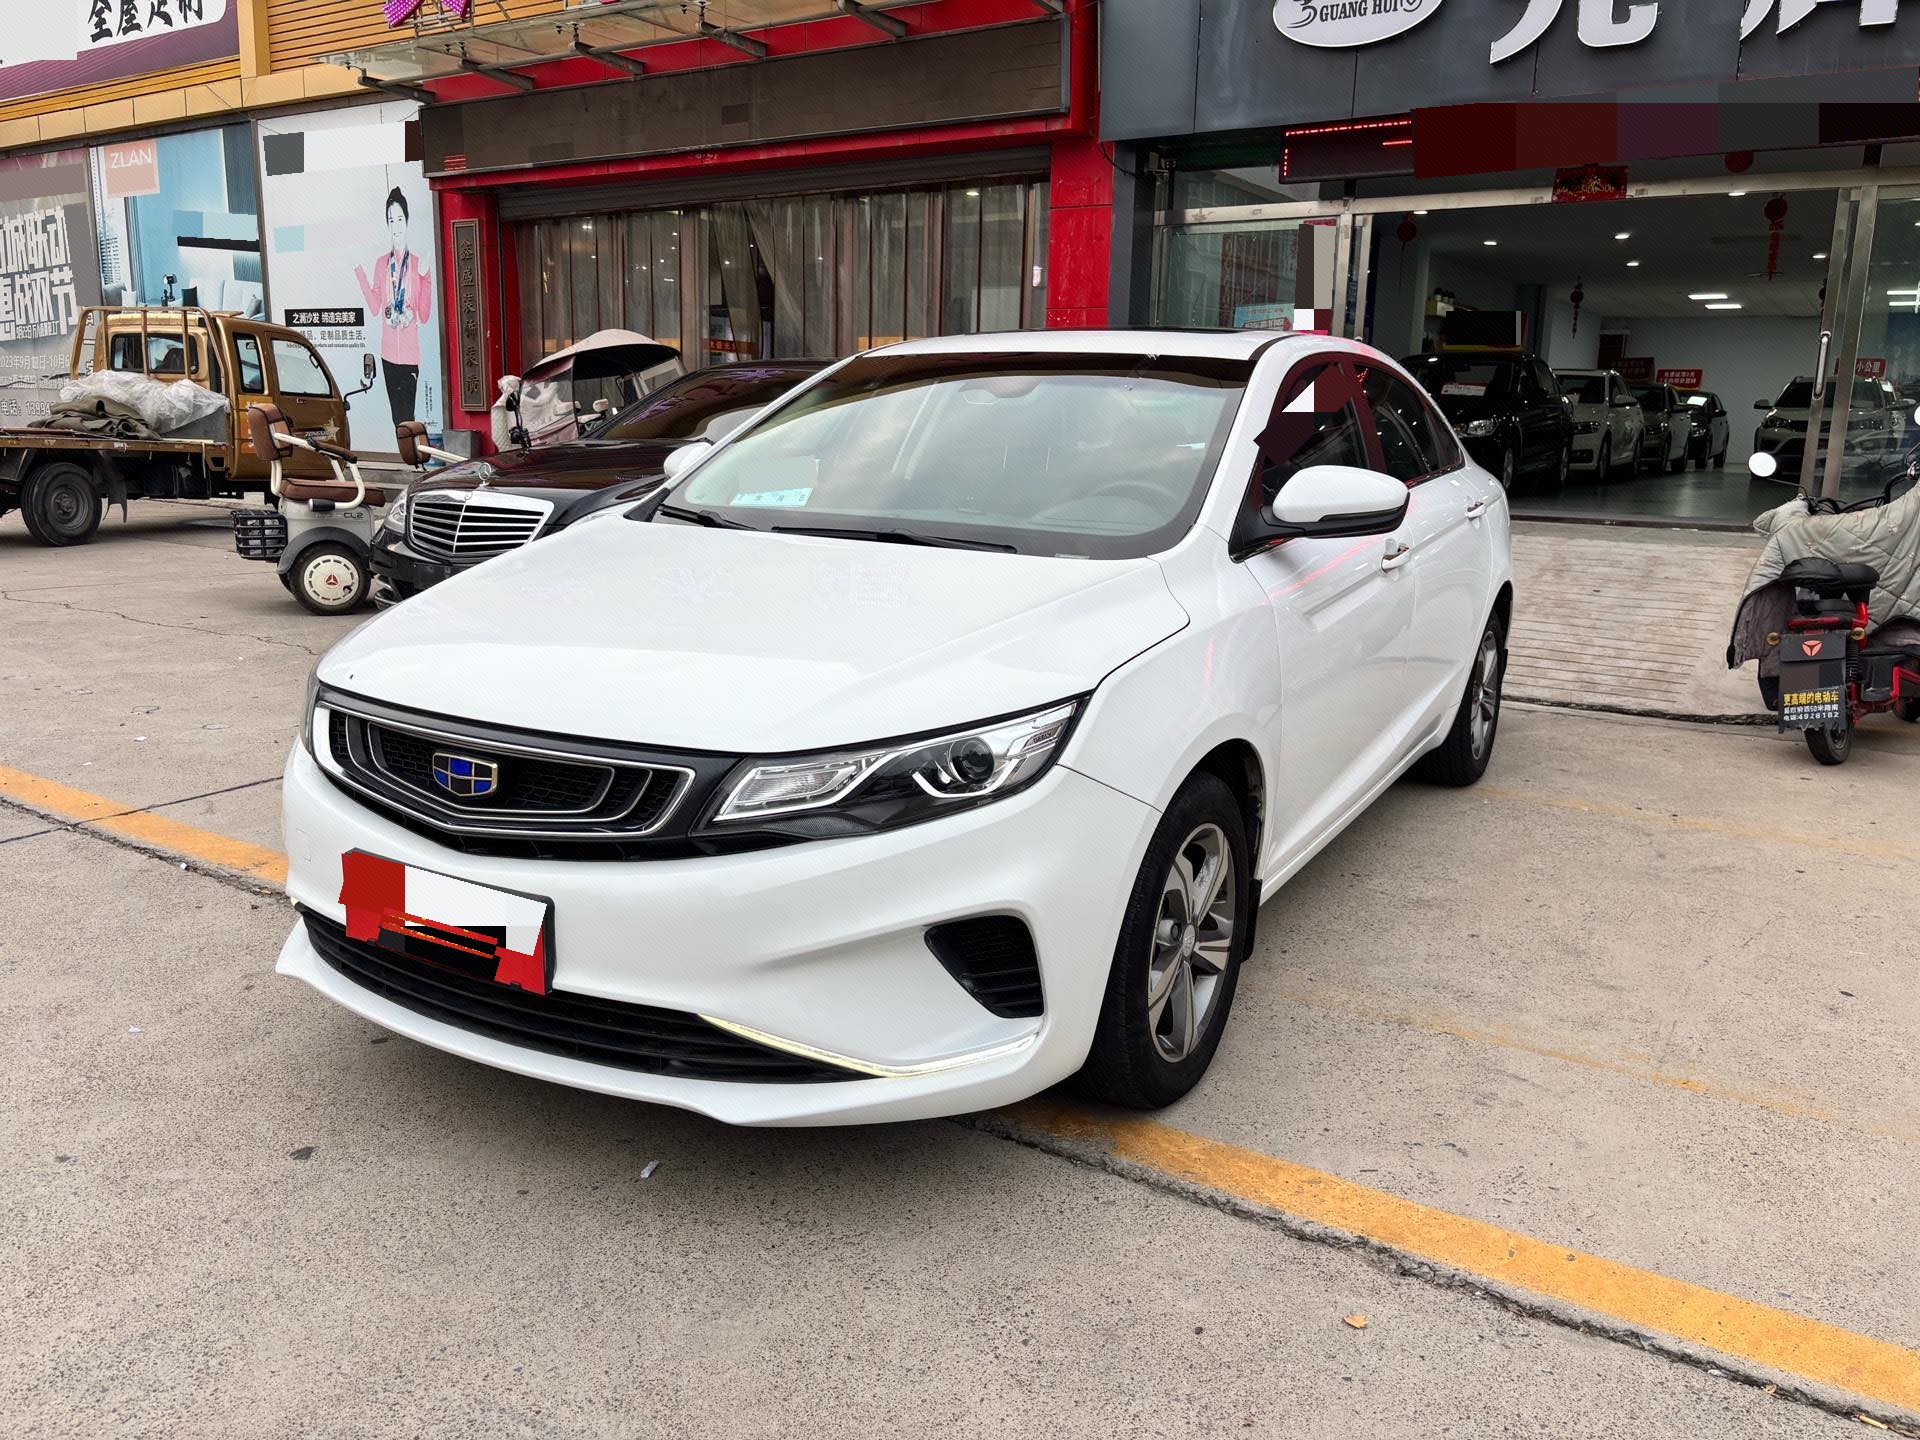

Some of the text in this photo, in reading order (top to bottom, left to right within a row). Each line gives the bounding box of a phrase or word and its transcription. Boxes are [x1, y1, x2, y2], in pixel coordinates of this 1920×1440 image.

[1320, 0, 1398, 22] GUANG HUI
[110, 148, 152, 168] ZLAN
[1783, 690, 1839, 706] 更高端的电动车
